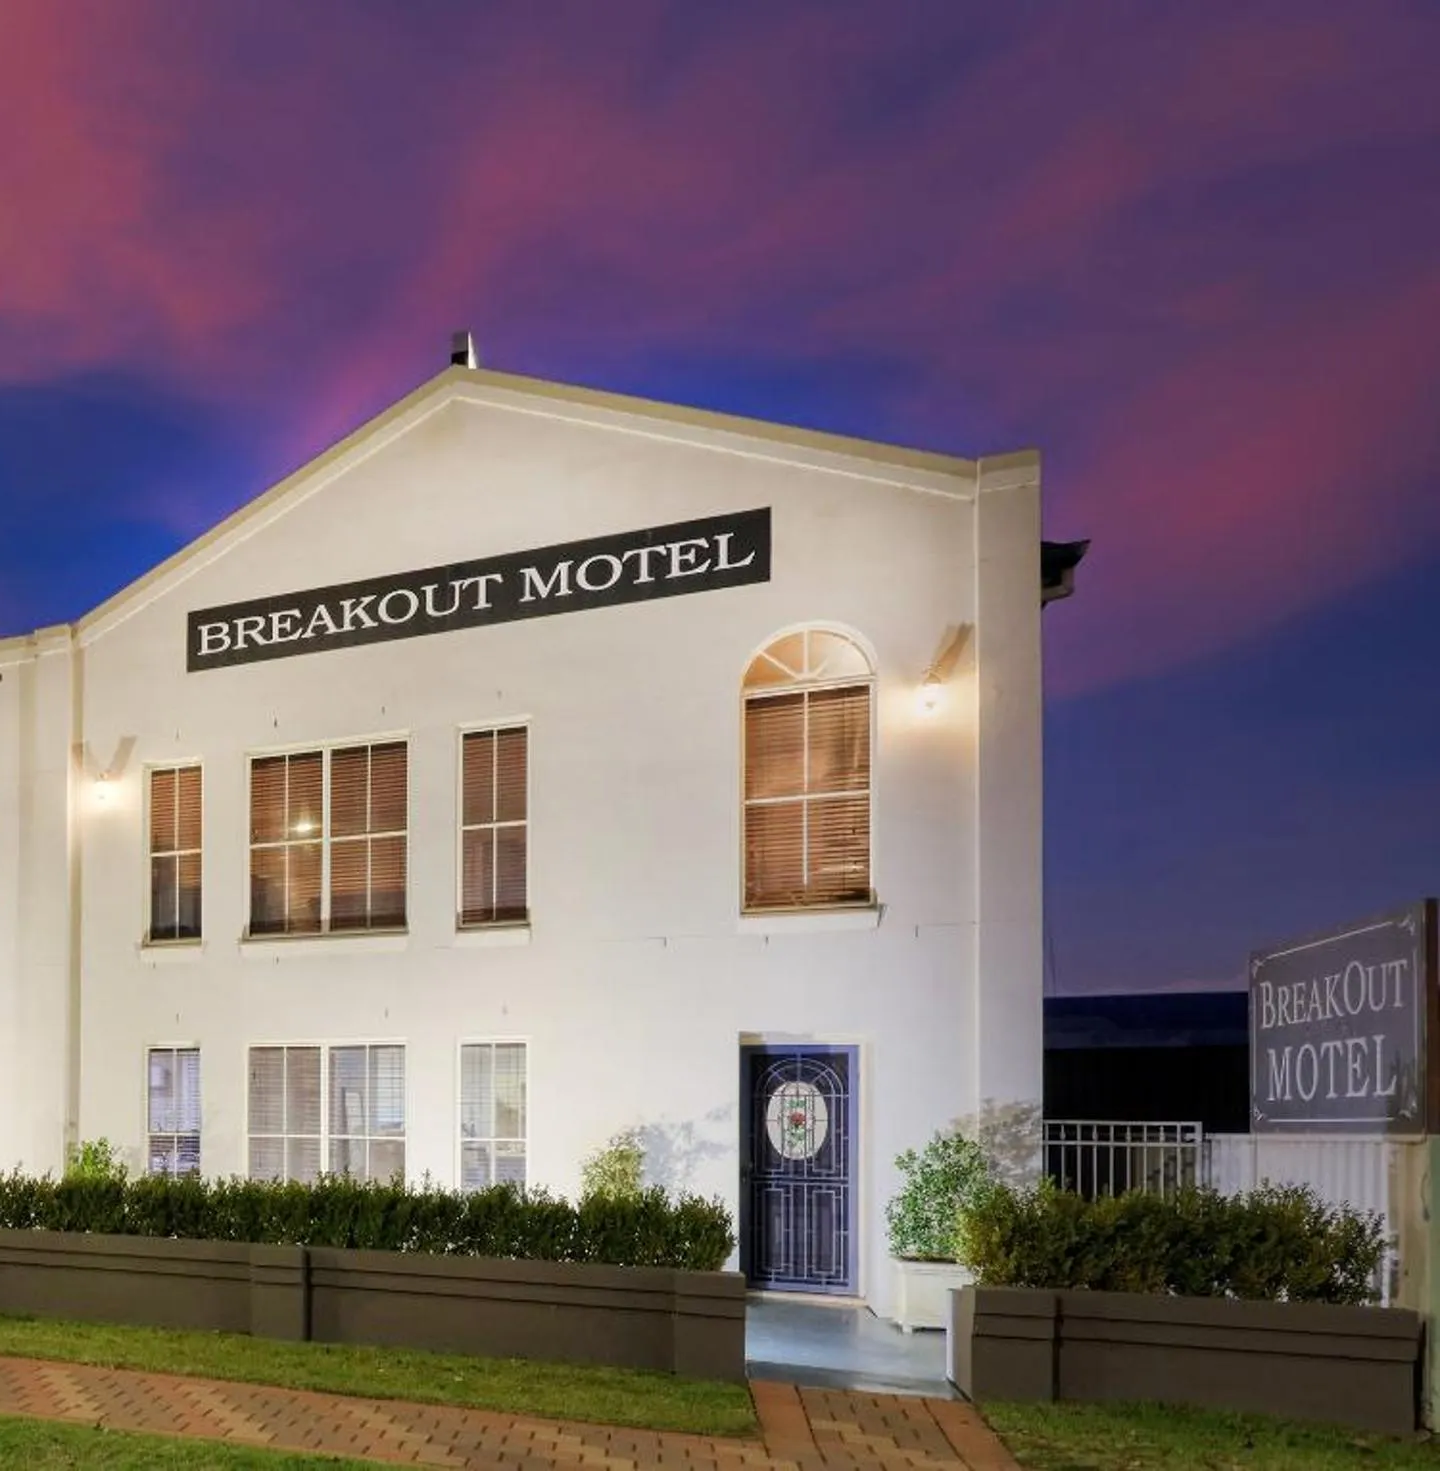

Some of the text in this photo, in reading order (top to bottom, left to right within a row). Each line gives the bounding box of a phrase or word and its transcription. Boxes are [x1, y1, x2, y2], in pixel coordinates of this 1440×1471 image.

[197, 532, 756, 656] BREAKOUT MOTEL
[1266, 1034, 1397, 1101] MOTEL
